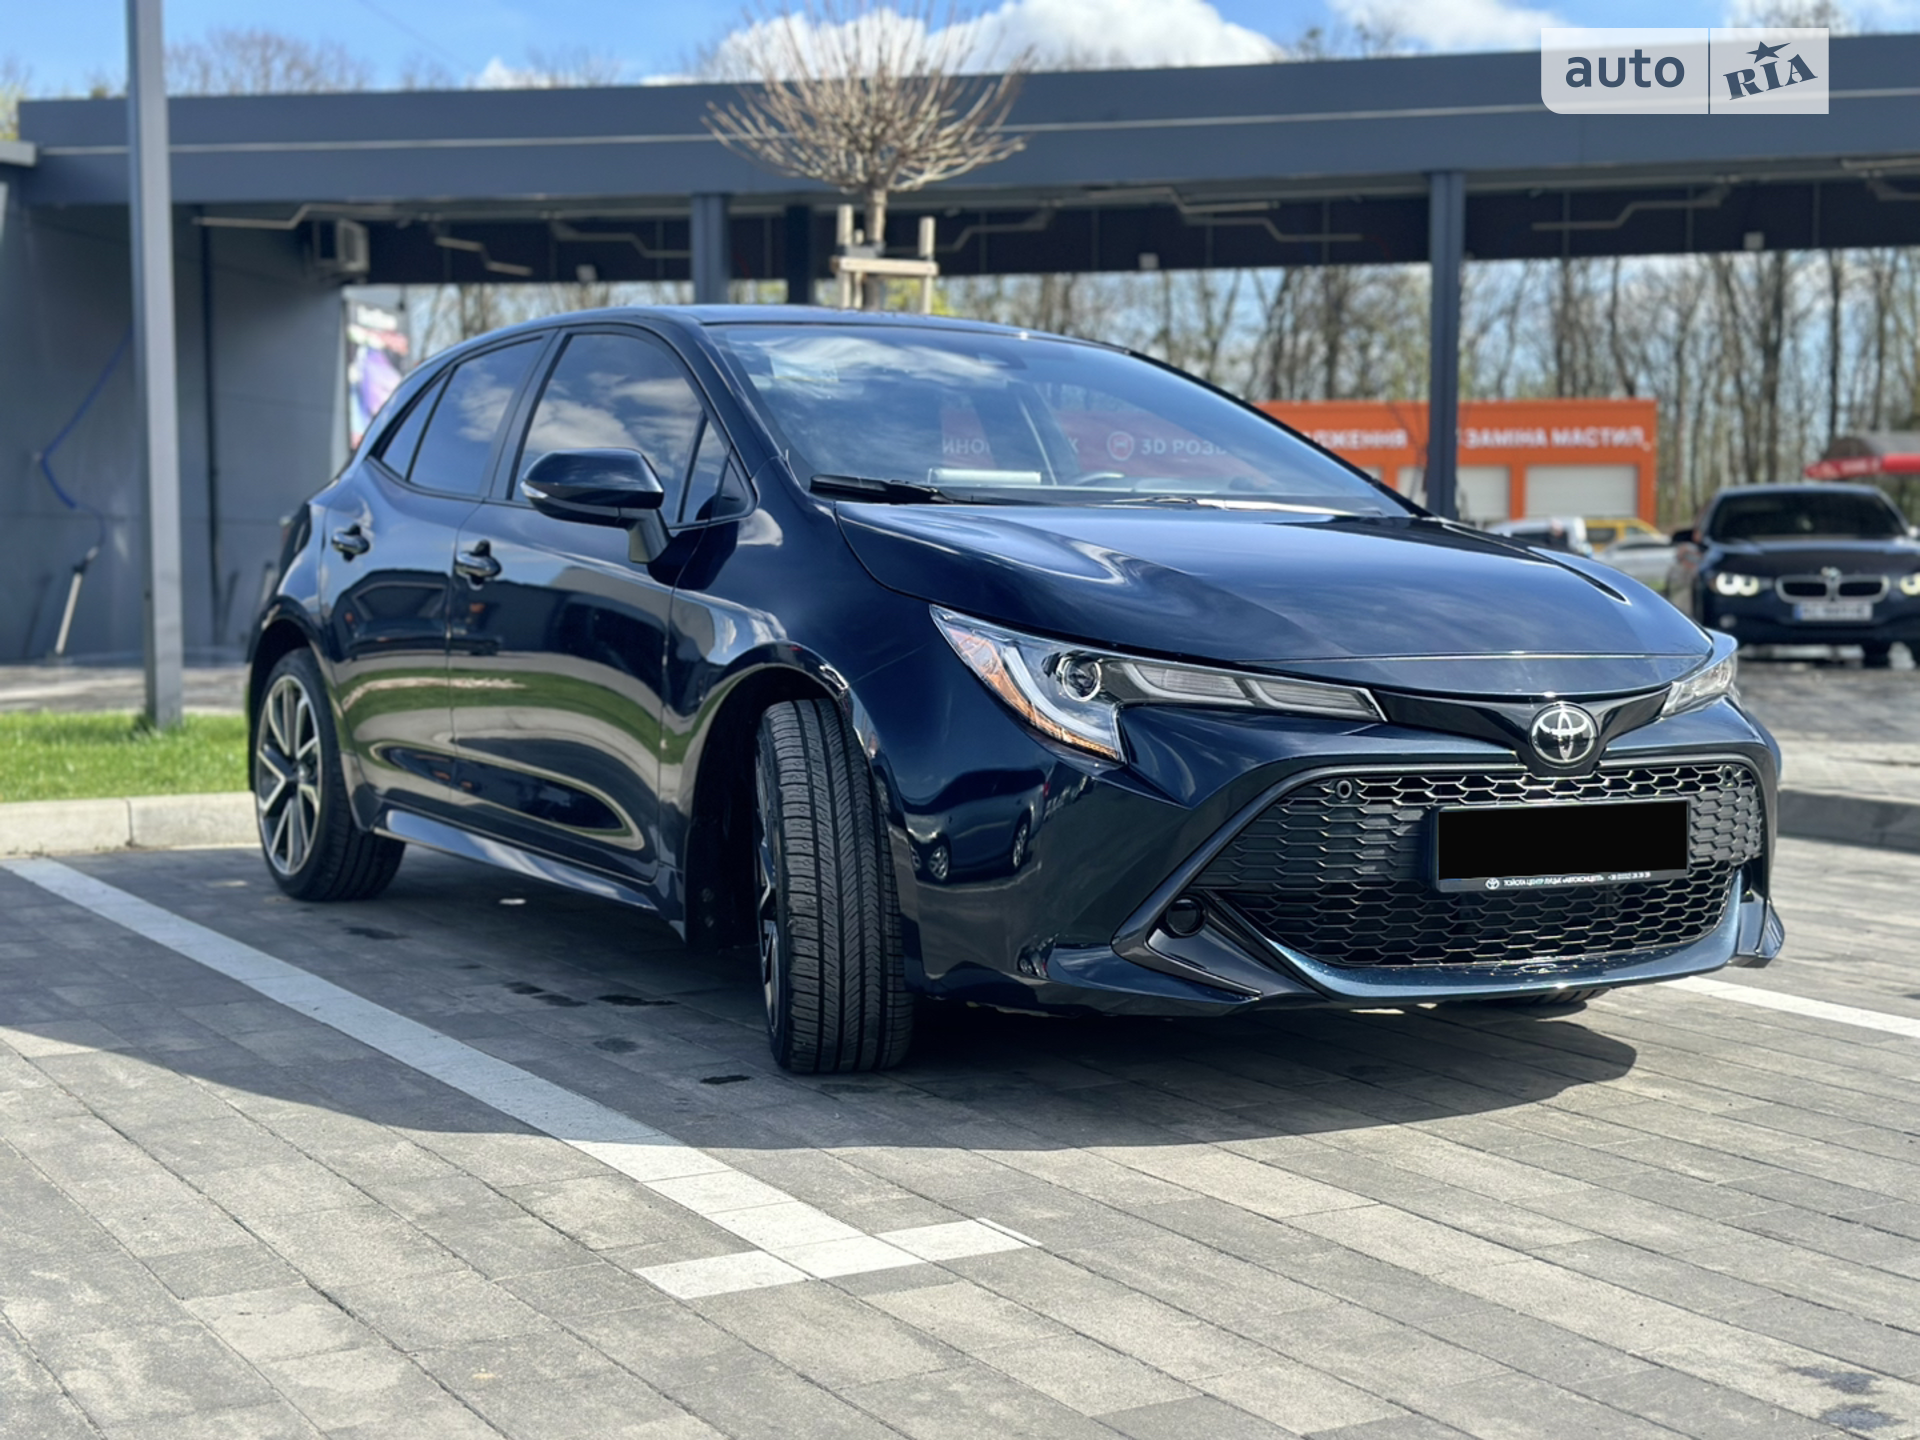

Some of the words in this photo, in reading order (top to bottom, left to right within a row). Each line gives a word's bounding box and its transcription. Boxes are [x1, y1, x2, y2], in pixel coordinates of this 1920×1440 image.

[1141, 438, 1166, 455] 3D
[1303, 428, 1408, 450] ДЖЕННЯ
[1464, 427, 1548, 449] ЗАМІНА
[1551, 426, 1644, 448] МАСТИЛ
